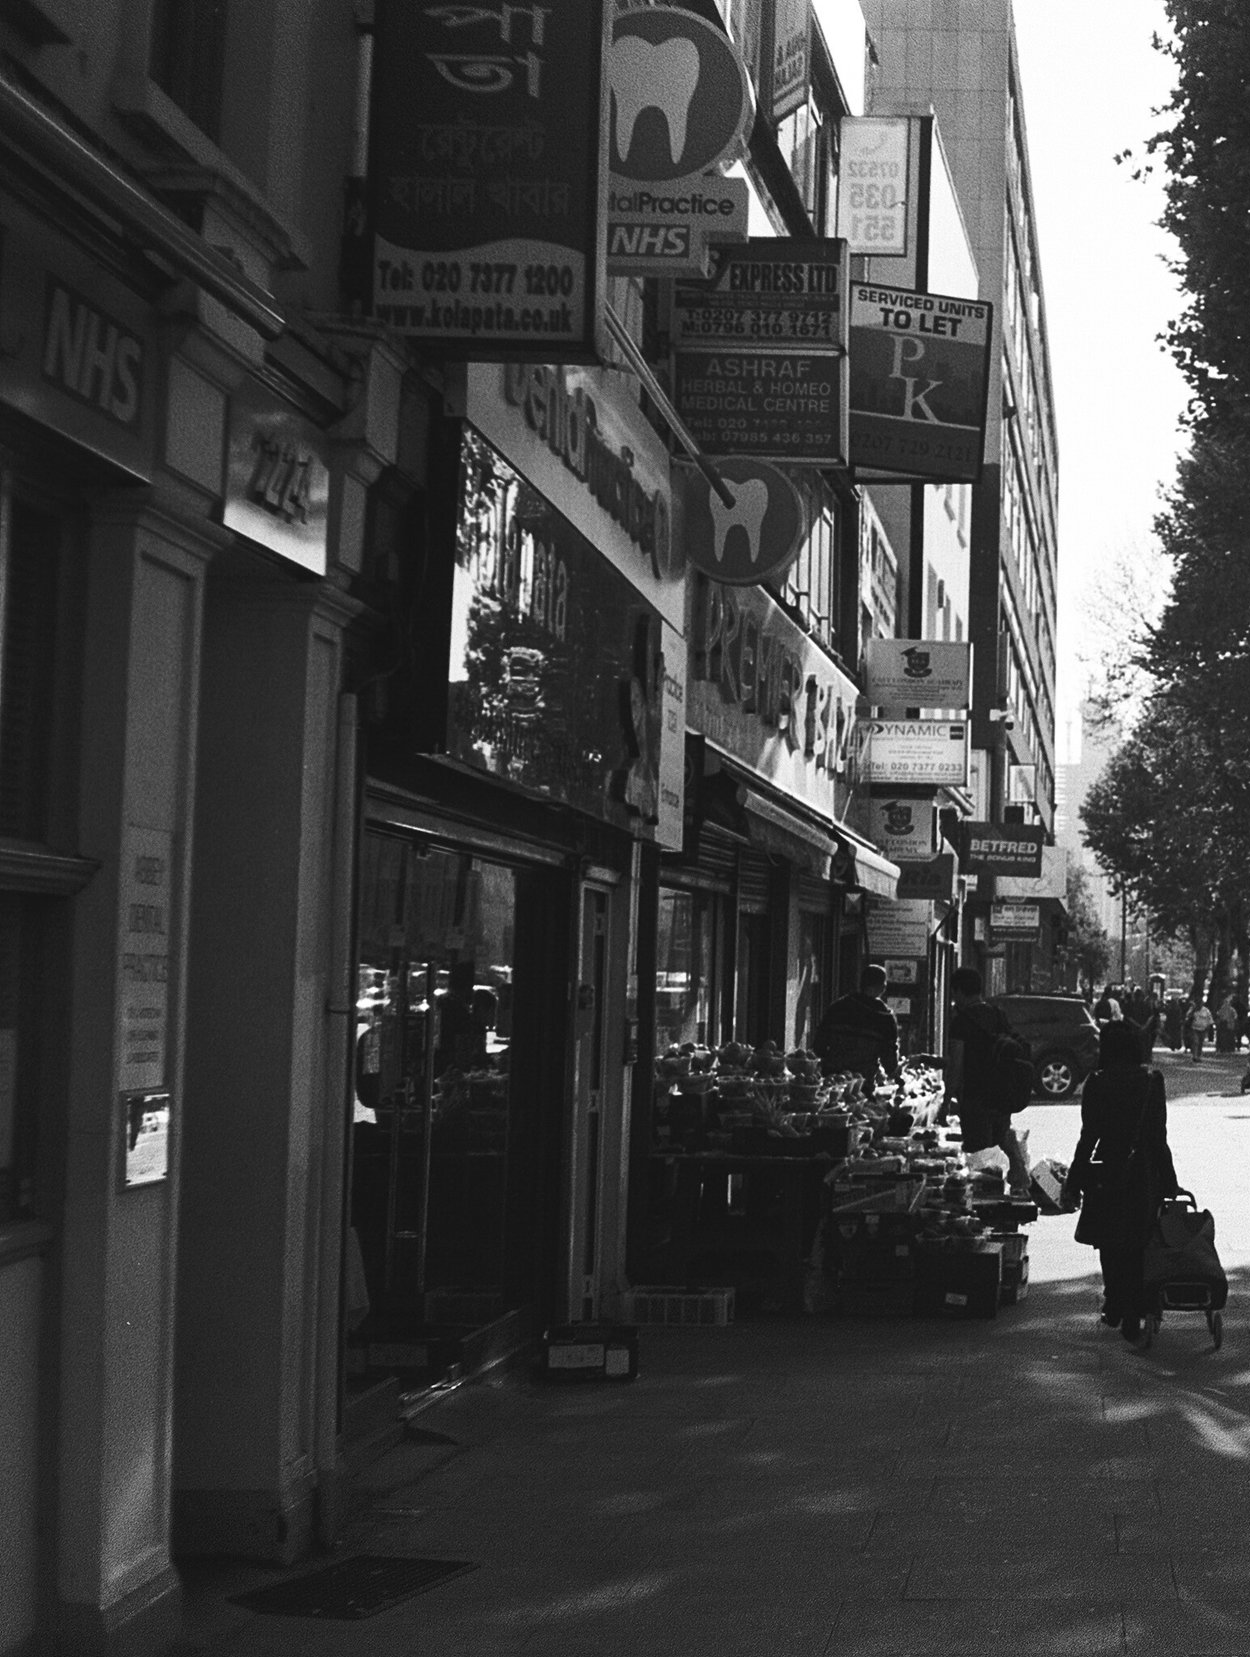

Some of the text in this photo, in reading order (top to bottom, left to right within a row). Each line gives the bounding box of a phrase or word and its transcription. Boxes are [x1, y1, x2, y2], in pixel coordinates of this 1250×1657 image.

[609, 226, 685, 255] NHS
[377, 260, 572, 297] Tel: 020 7377 1200
[728, 262, 803, 293] EXPRESS
[805, 264, 837, 293] LTD
[374, 299, 572, 335] www.kolapata.co.uk
[858, 288, 934, 311] SERVICED
[938, 301, 985, 319] UNITS
[879, 307, 962, 337] TO LET
[44, 286, 141, 424] NHS
[705, 357, 812, 378] ASHRAF
[680, 378, 832, 397] HERBAL & HOMEO
[680, 395, 831, 414] MEDICAL CENTRE
[969, 838, 1038, 855] BETFRED
